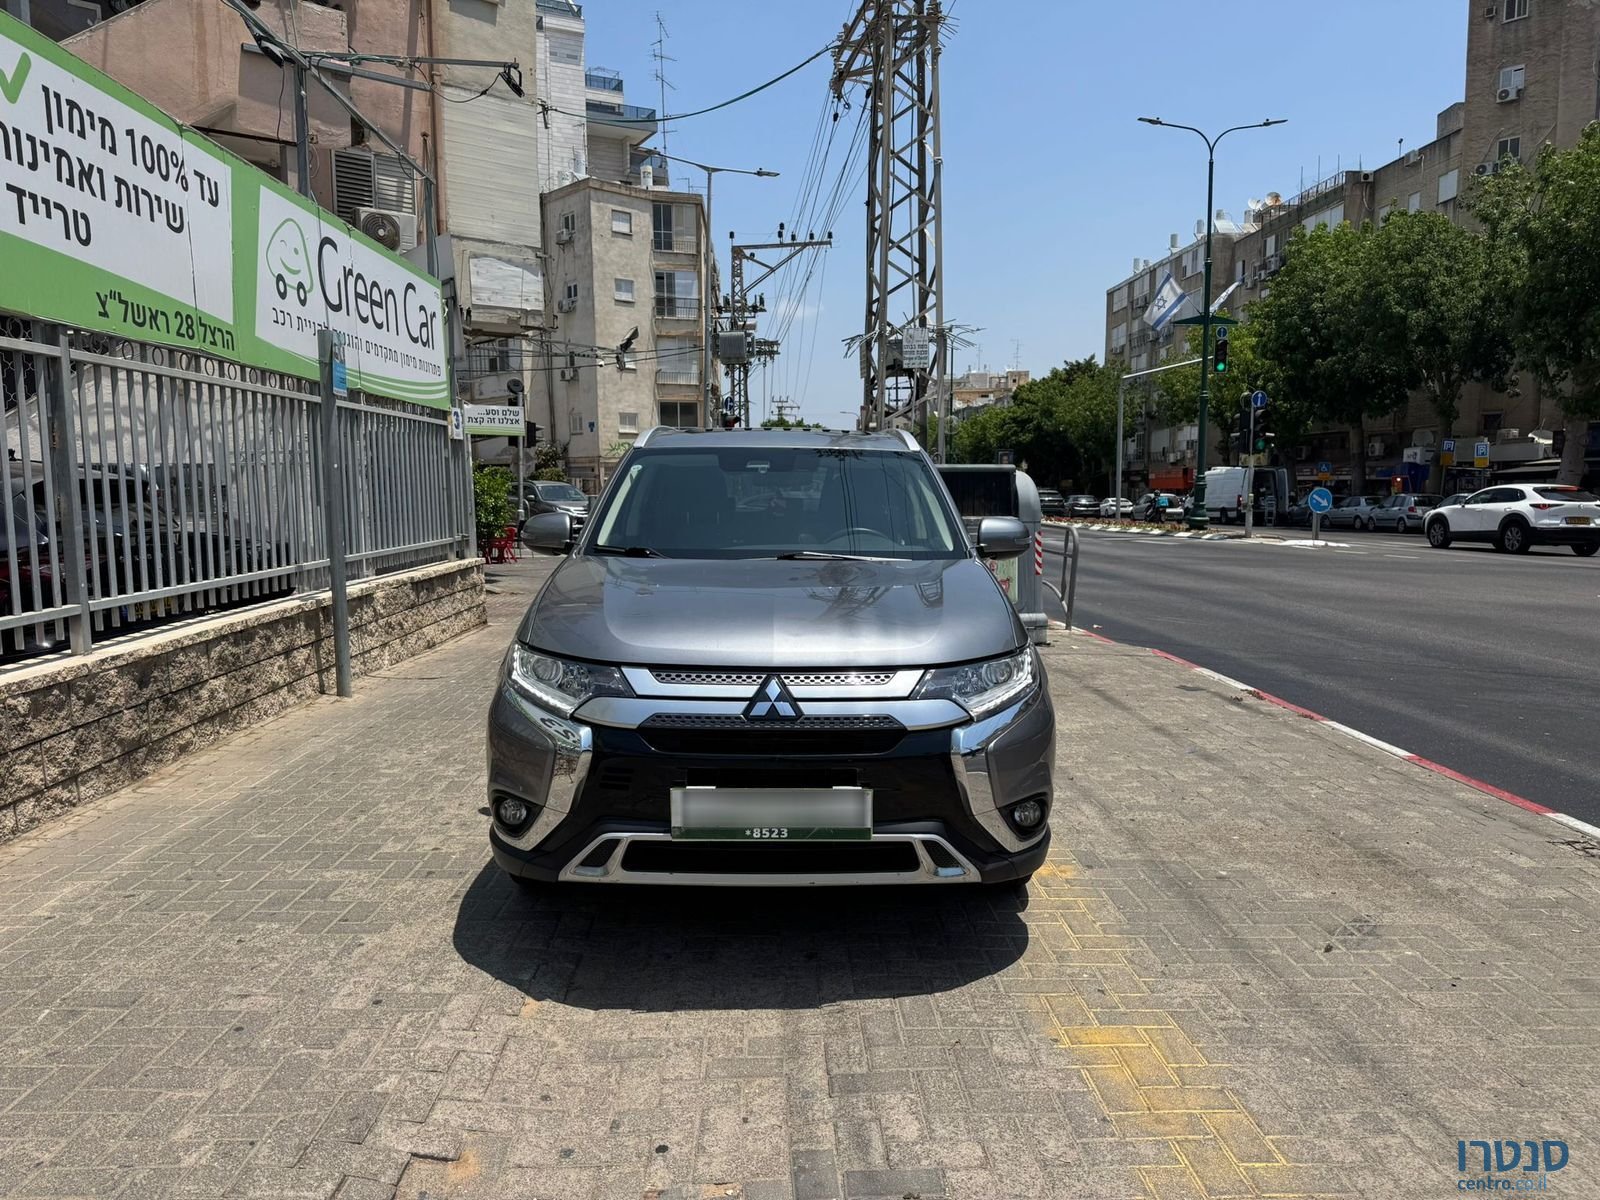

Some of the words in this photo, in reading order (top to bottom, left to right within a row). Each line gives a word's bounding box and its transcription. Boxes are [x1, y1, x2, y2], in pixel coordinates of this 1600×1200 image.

[41, 84, 118, 156] מימון
[125, 128, 189, 192] 100%
[114, 174, 184, 233] שירות
[193, 169, 219, 207] עד
[6, 182, 92, 246] טרייד
[317, 236, 399, 336] Green
[403, 282, 437, 350] Car
[174, 311, 195, 340] 28
[198, 316, 235, 351] הרצל
[272, 307, 293, 328] רכב
[365, 340, 399, 363] מתקדמים
[467, 416, 485, 425] קצת
[501, 408, 520, 416] שלם
